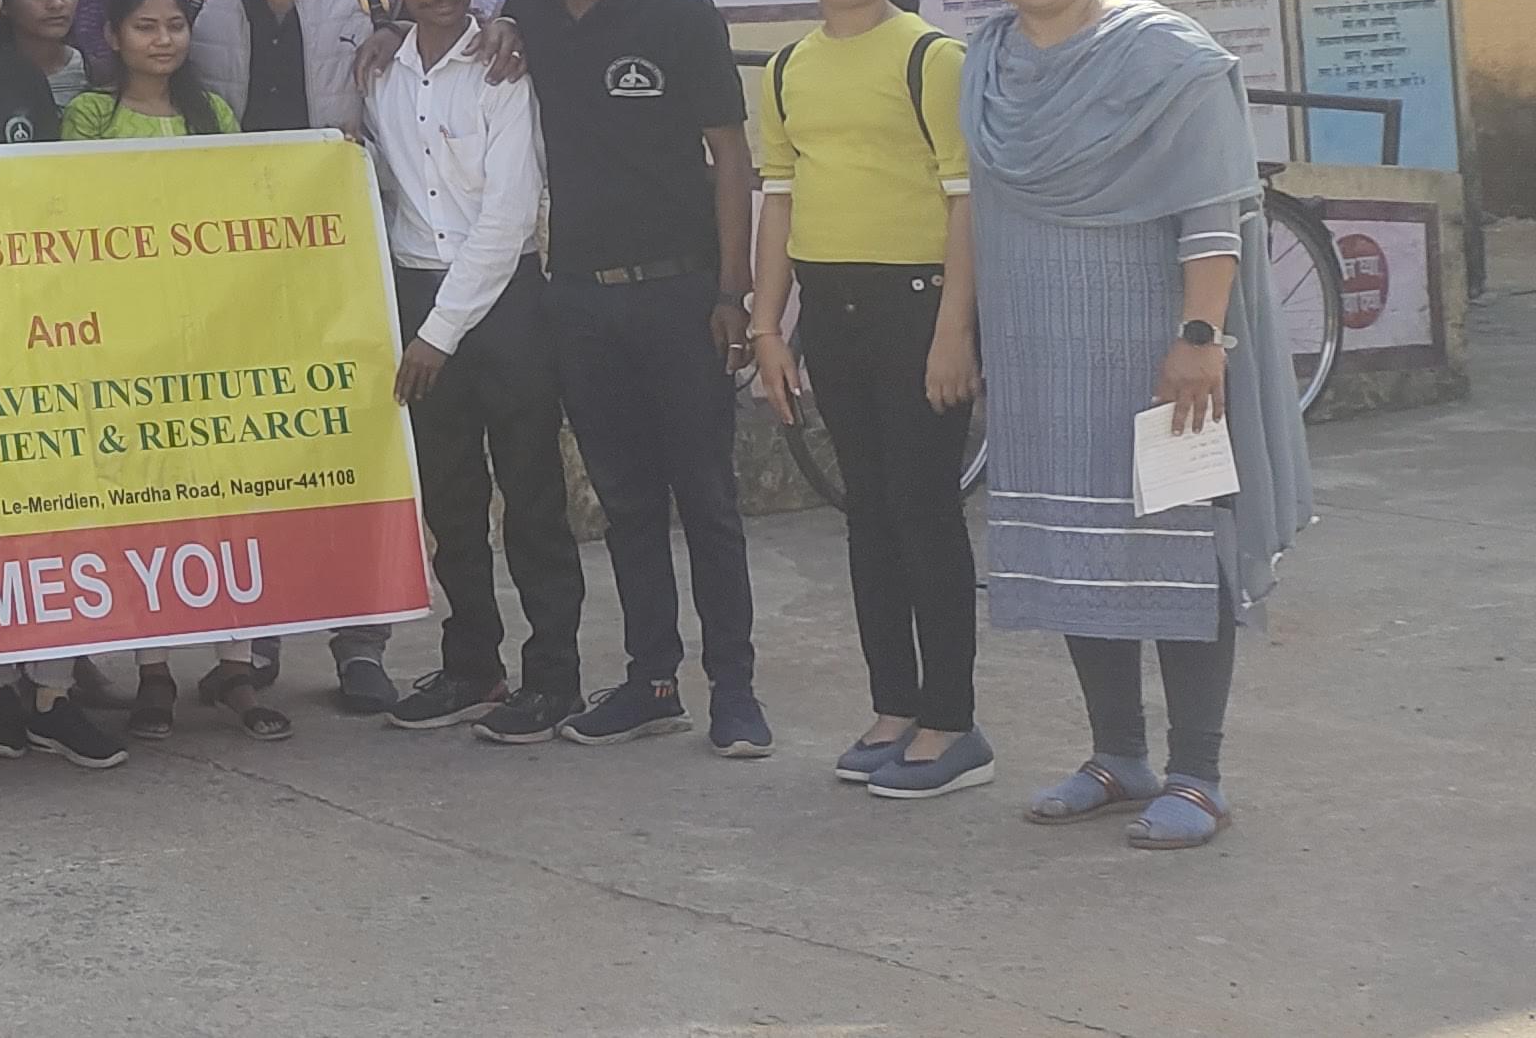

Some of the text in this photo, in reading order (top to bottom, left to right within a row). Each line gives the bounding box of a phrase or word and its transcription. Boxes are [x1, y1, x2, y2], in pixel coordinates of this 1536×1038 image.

[170, 212, 347, 257] SCHEME
[27, 311, 101, 351] And
[90, 367, 294, 411] INSTITUTE
[306, 361, 358, 393] OF
[98, 425, 127, 453] &
[139, 405, 352, 449] RESEARCH
[1, 491, 106, 516] Le-Meridien,
[108, 484, 173, 507] Wardha
[175, 479, 226, 502] Road,
[230, 468, 355, 499] Nagpur-441108
[121, 537, 264, 614] YOU
